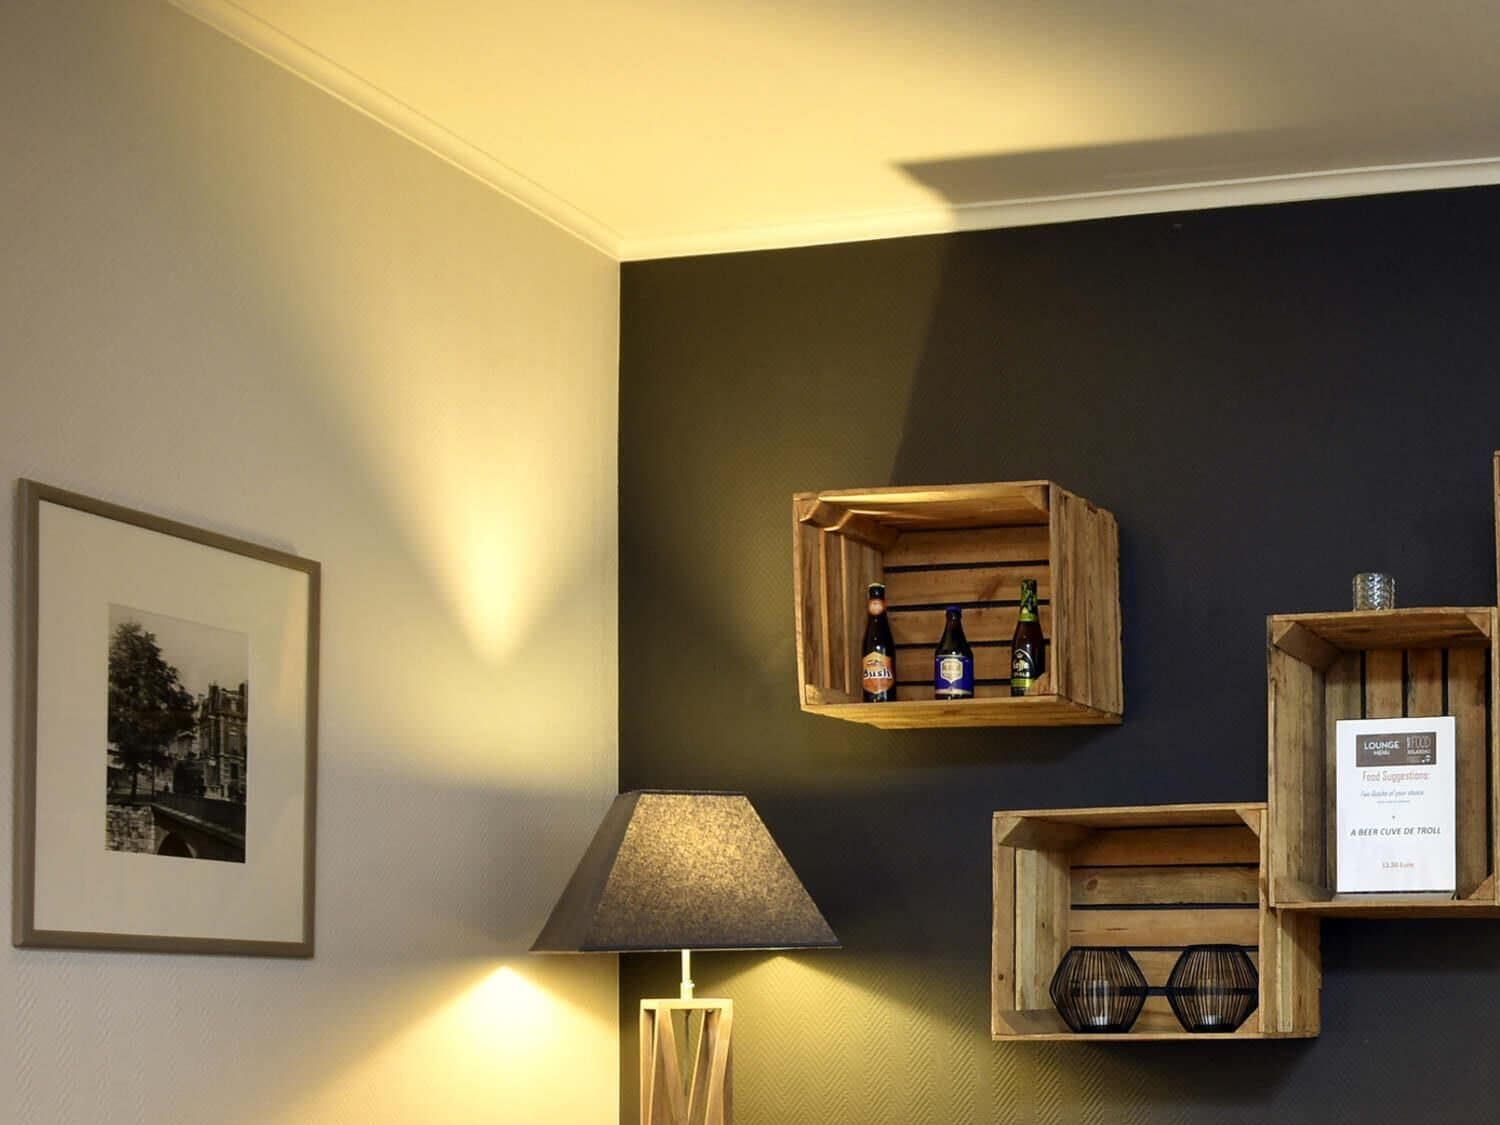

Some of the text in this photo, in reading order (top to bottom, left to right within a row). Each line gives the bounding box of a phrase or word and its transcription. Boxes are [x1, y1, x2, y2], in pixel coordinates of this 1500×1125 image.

[1364, 740, 1400, 750] LOUNGE
[1363, 770, 1380, 782] Food
[1350, 826, 1441, 836] A BEER CUVE DE TROLL
